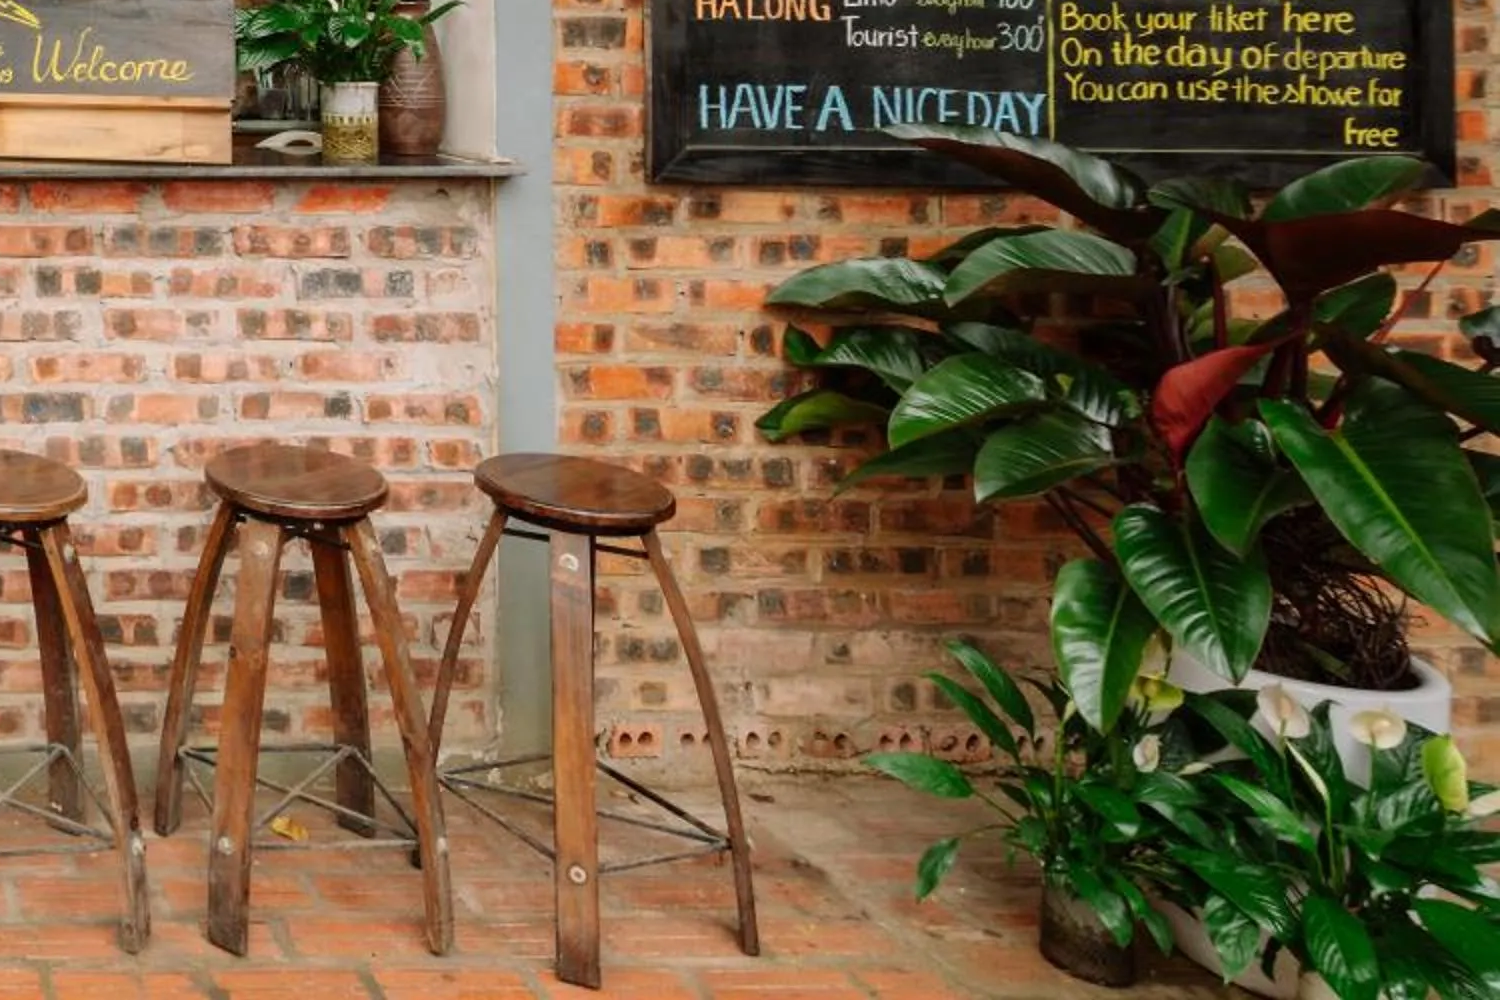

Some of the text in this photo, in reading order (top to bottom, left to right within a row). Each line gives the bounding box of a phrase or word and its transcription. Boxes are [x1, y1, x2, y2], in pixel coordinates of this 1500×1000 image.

[841, 16, 918, 47] Tourist
[1060, 2, 1355, 37] Book your tiket here
[32, 27, 195, 83] Welcome
[1061, 38, 1102, 67] On
[1111, 33, 1160, 67] the
[1166, 36, 1231, 76] day
[1283, 38, 1407, 79] departure
[700, 84, 807, 130] HAVE
[816, 86, 855, 132] A
[1177, 78, 1228, 101] use
